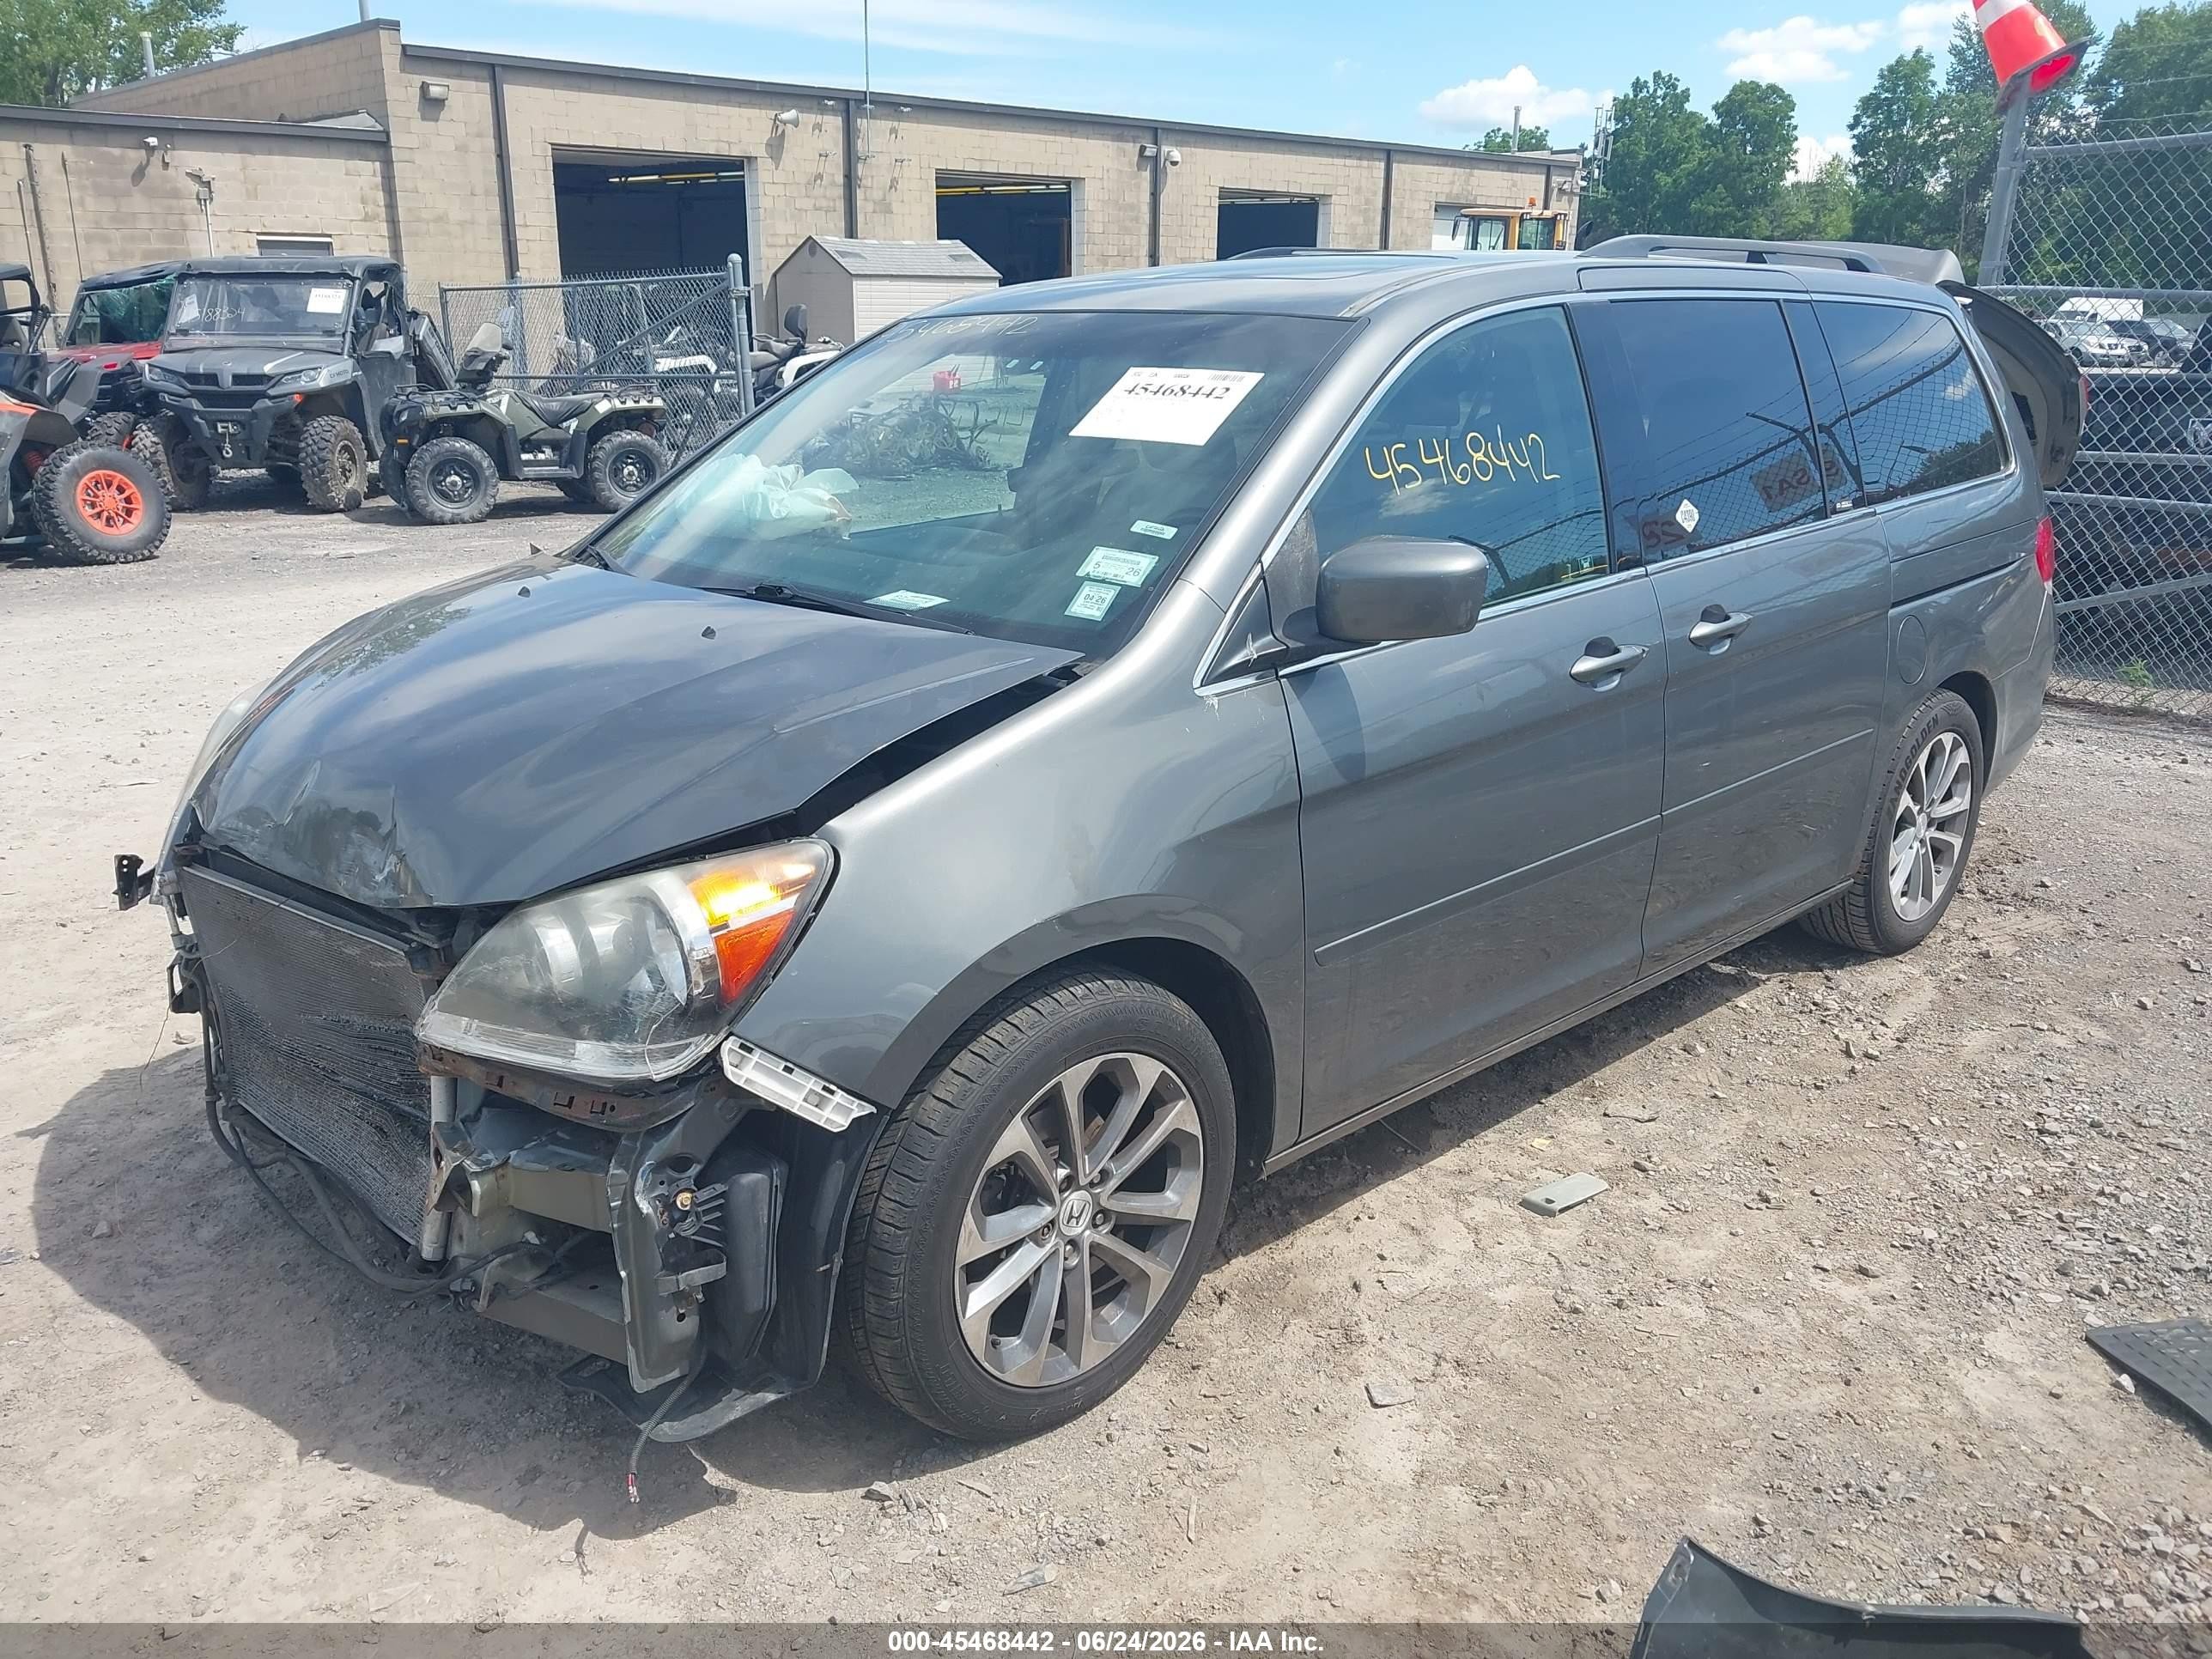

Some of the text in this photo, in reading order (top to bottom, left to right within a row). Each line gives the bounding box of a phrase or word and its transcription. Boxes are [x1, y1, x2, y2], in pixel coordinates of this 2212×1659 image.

[1124, 383, 1231, 399] 45468442
[1364, 424, 1561, 495] 45468442
[1093, 561, 1101, 570] 5
[1124, 567, 1142, 578] 26
